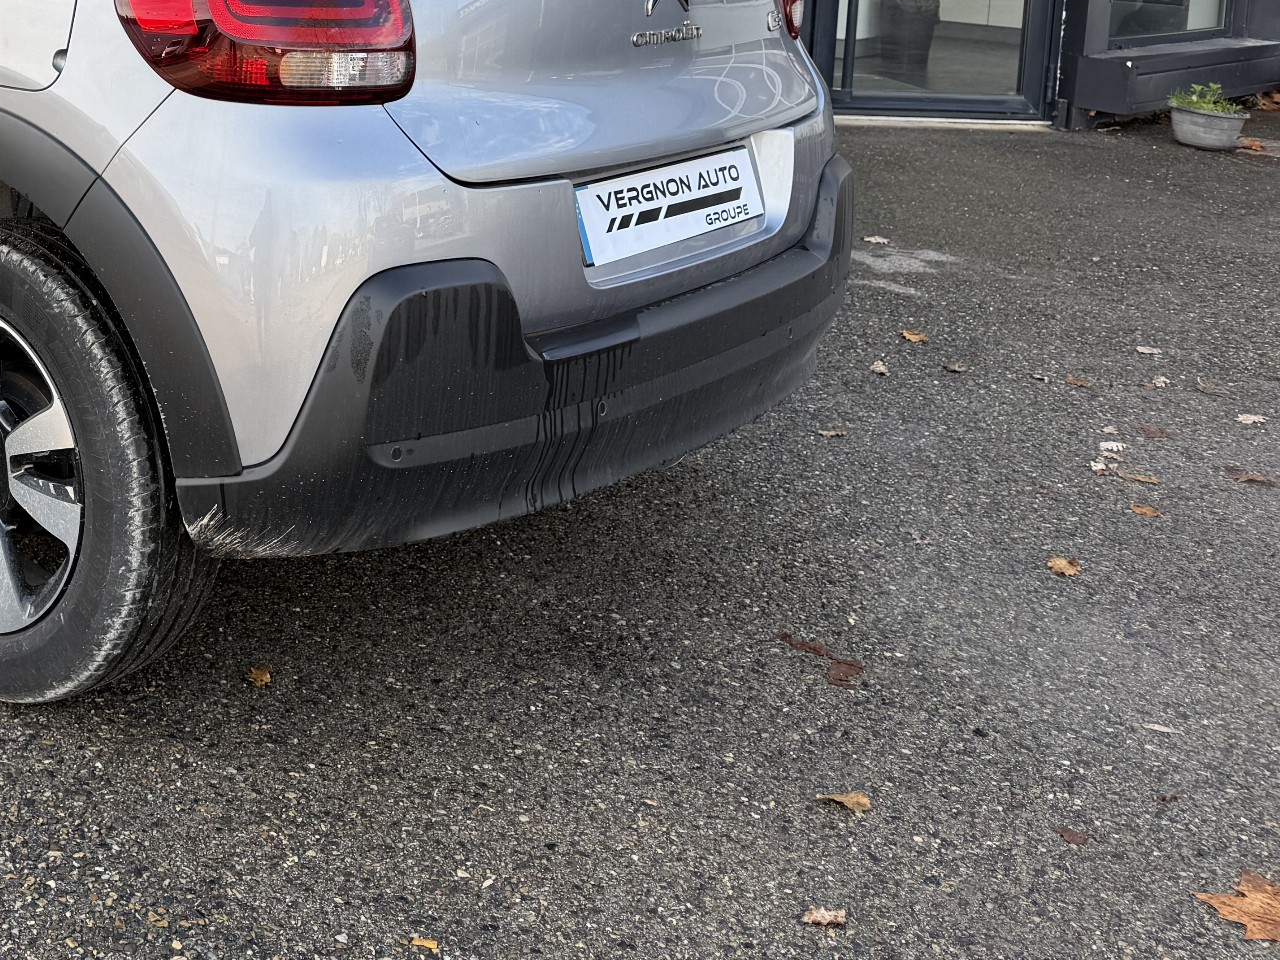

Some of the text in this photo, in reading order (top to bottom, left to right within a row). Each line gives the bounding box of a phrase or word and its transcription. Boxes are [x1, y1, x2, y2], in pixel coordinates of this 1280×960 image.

[595, 163, 741, 212] VERGNON AUTO
[705, 203, 750, 226] GROUPE
